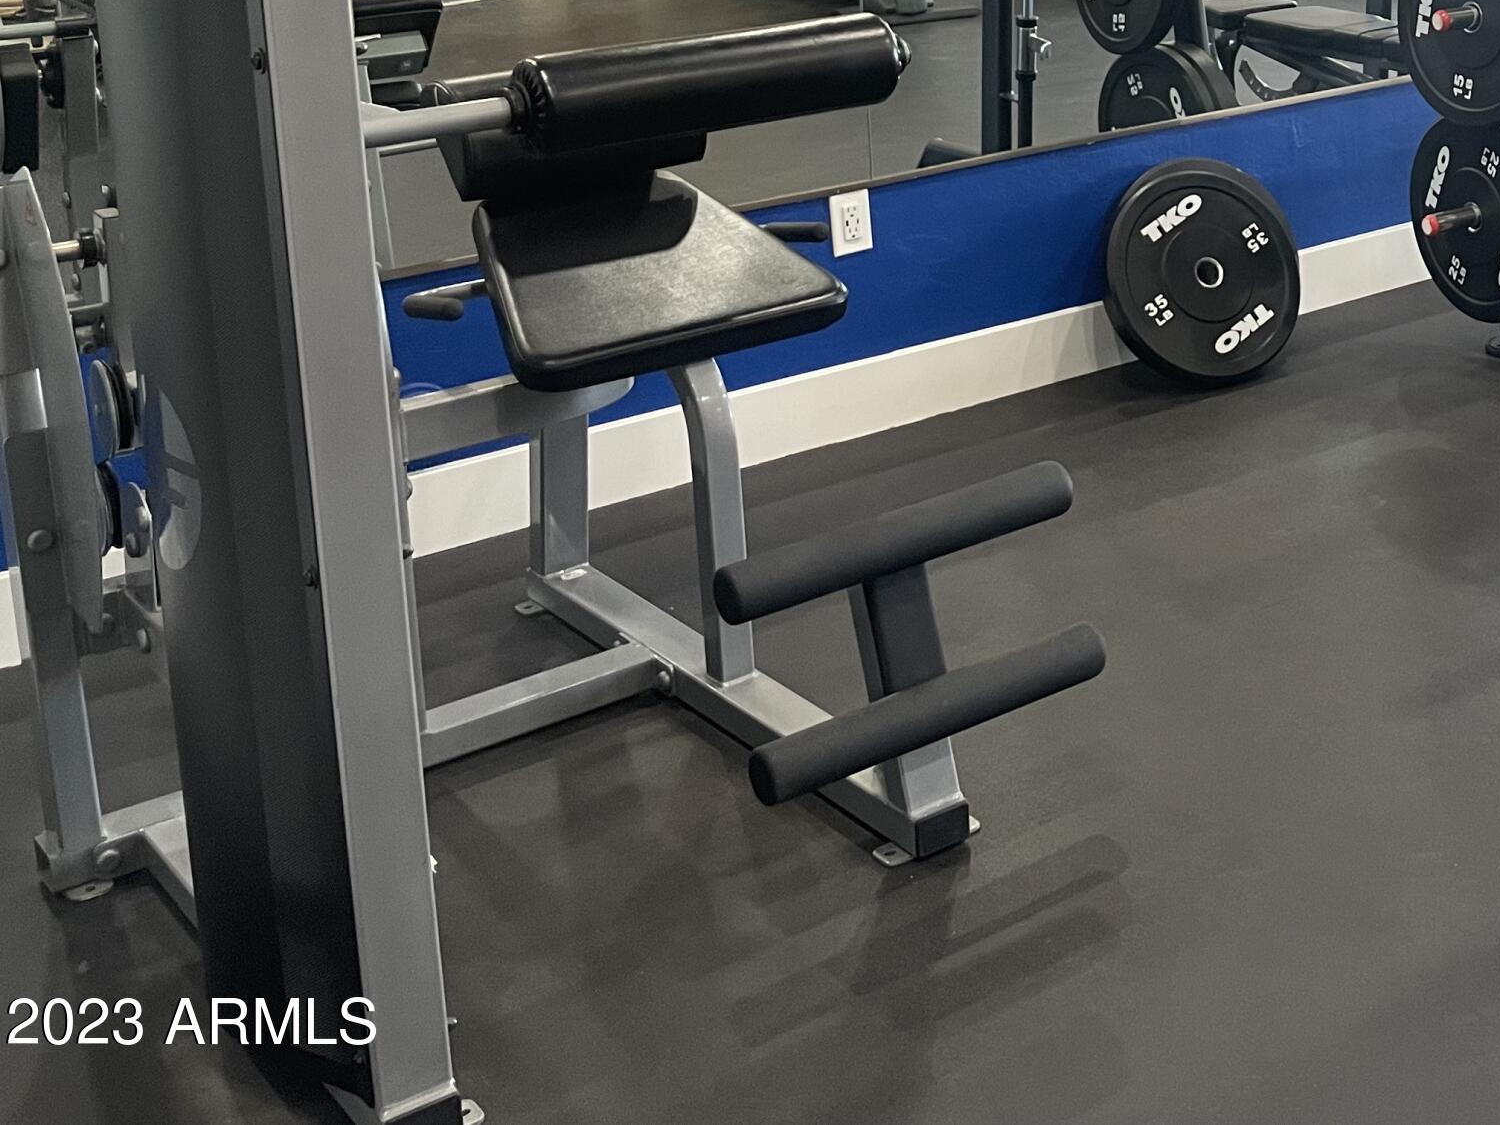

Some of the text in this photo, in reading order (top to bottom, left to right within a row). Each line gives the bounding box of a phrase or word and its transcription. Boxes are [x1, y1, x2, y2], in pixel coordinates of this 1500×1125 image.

[1453, 74, 1464, 97] 15
[1464, 78, 1474, 100] LB
[1480, 147, 1490, 165] LB
[1487, 151, 1500, 179] 25
[1425, 145, 1450, 209] TKO
[1140, 194, 1203, 243] TKO
[1241, 222, 1259, 239] LB
[1246, 231, 1269, 254] 35
[1448, 255, 1461, 282] 25
[1457, 266, 1467, 286] LB
[1144, 293, 1169, 317] 35
[1155, 309, 1174, 326] LB
[1214, 303, 1275, 354] TKO
